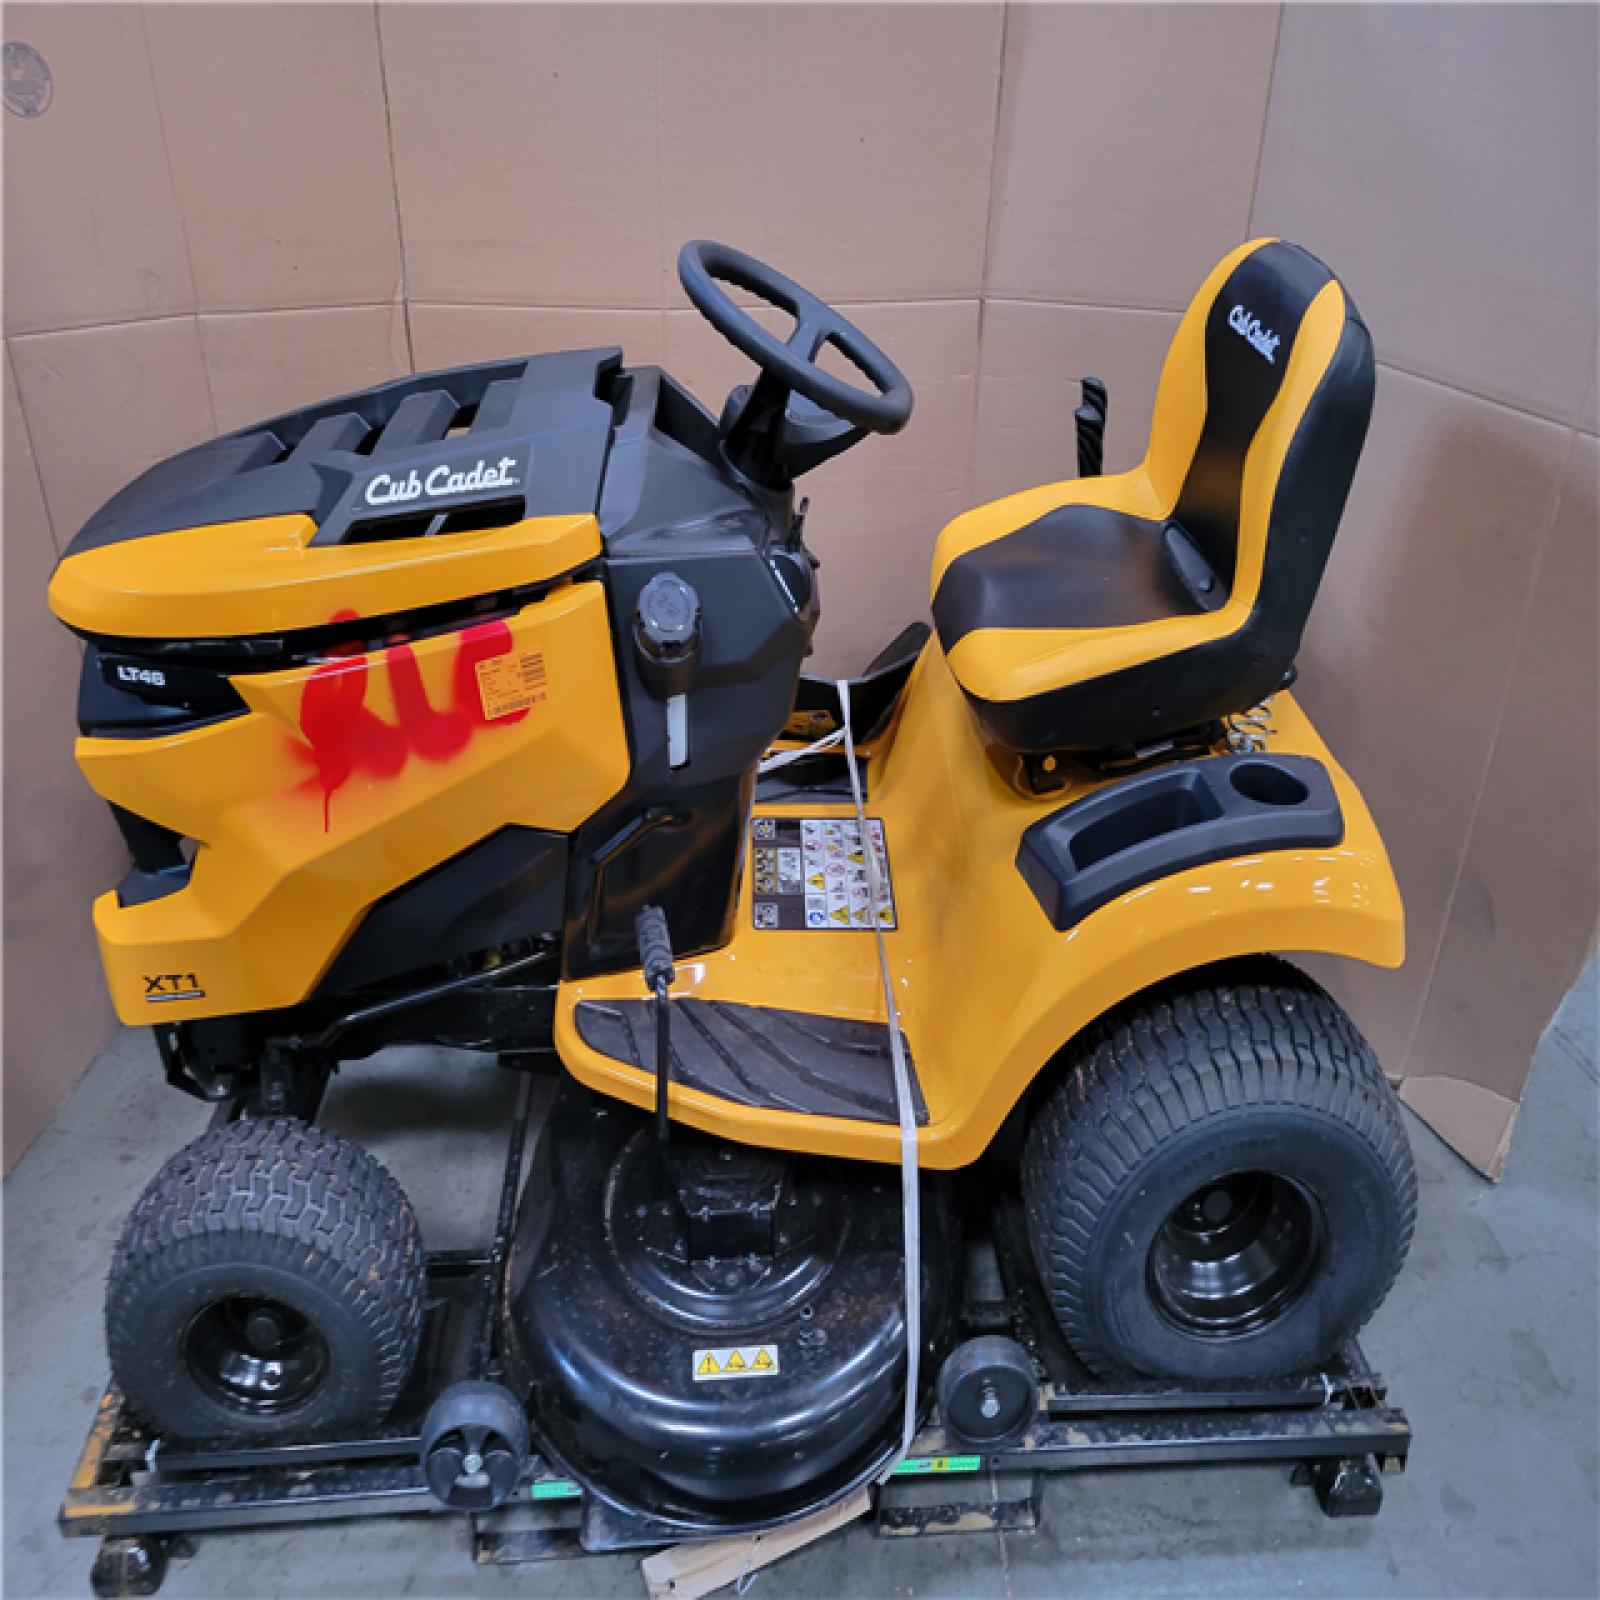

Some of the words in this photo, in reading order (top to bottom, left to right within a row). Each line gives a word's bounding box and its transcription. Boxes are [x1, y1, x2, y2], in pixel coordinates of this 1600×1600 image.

[365, 469, 422, 505] Cub
[425, 456, 517, 496] Cadet
[143, 972, 199, 993] XT1
